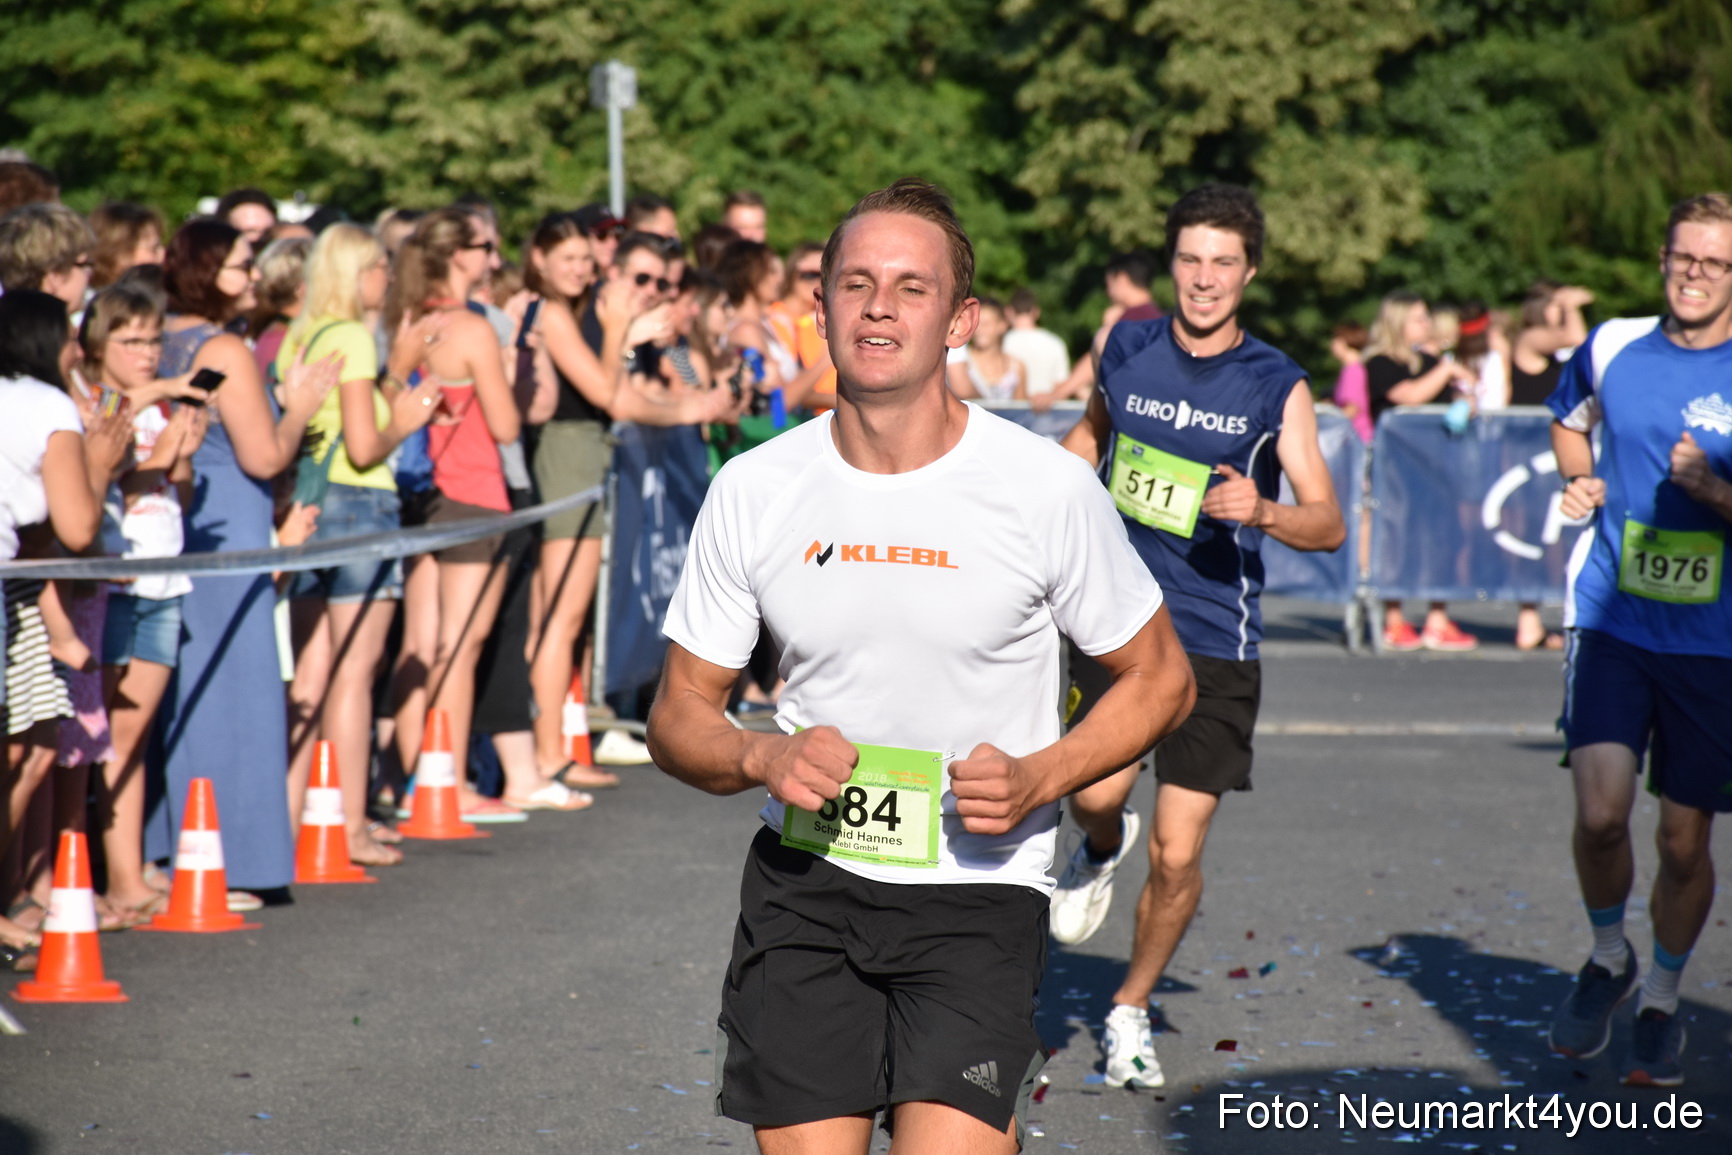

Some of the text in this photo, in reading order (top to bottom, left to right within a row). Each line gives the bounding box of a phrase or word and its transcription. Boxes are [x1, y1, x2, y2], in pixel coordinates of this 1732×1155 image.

[1190, 410, 1249, 435] POLES
[1125, 469, 1175, 508] 511
[841, 544, 959, 569] KLEBL
[1634, 552, 1708, 583] 1976
[858, 771, 887, 783] 2018
[814, 821, 903, 846] Schmid Hannes
[832, 838, 879, 853] Klebl GmbH
[962, 1070, 1001, 1097] adidas
